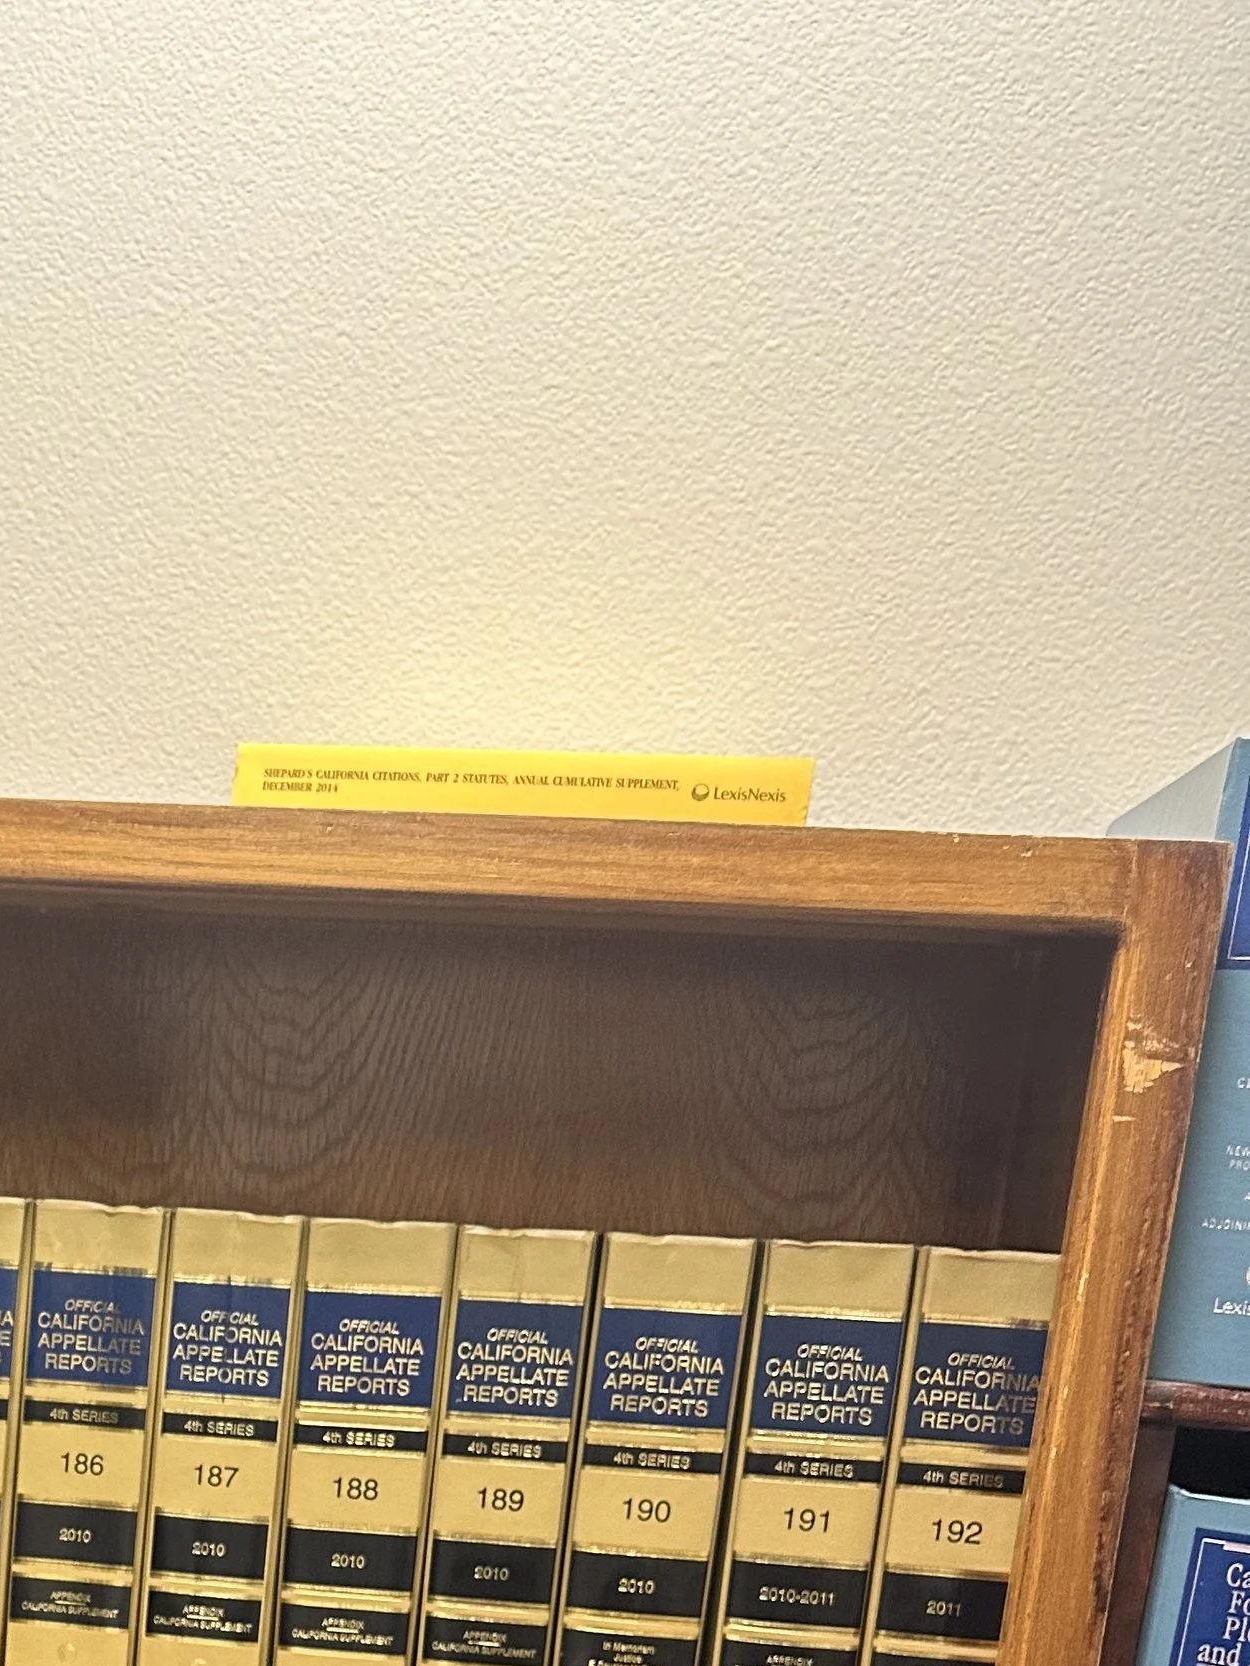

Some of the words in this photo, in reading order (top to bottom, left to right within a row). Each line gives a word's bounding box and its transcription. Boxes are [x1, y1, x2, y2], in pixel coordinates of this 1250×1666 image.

[262, 782, 312, 792] DECEMBER
[315, 783, 338, 793] 2014
[264, 769, 312, 779] SHEPARD'S
[316, 770, 369, 781] CALIFORNIA
[426, 773, 449, 783] PART
[453, 774, 459, 783] 2
[462, 774, 509, 785] STATUTES,
[513, 776, 549, 785] ANNUAL
[553, 776, 612, 788] CUMULATIVE
[616, 778, 679, 791] SUPPLEMENT,
[713, 786, 786, 803] LexisNexis
[38, 1312, 145, 1336] CALIFORNIA
[173, 1323, 282, 1347] CALIFORNIA
[339, 1318, 400, 1334] OFFICIAL
[38, 1333, 141, 1355] APPELLATE
[311, 1333, 424, 1355] CALIFORNIA
[487, 1328, 548, 1345] OFFICIAL
[636, 1336, 698, 1354] OFFICIAL
[172, 1345, 279, 1367] APPELLATE
[458, 1342, 574, 1365] CALIFORNIA
[604, 1351, 724, 1376] CALIFORNIA
[797, 1344, 863, 1362] OFFICIAL
[948, 1352, 1015, 1370] OFFICIAL
[45, 1354, 132, 1375] REPORTS
[311, 1354, 421, 1376] APPELLATE
[456, 1364, 570, 1387] APPELLATE
[765, 1358, 890, 1383] CALIFORNIA
[180, 1365, 269, 1387] REPORTS
[318, 1376, 410, 1396] REPORTS
[603, 1372, 720, 1396] APPELLATE
[915, 1366, 1041, 1393] CALIFORNIA
[464, 1385, 558, 1407] REPORTS
[764, 1380, 884, 1404] APPELLATE
[913, 1389, 1036, 1414] APPELLATE
[610, 1394, 708, 1418] REPORTS
[771, 1402, 872, 1426] REPORTS
[184, 1422, 203, 1433] 4th
[207, 1423, 254, 1437] SERIES
[920, 1411, 1024, 1436] REPORTS
[322, 1433, 342, 1444] 4th
[346, 1432, 395, 1447] SERIES
[467, 1442, 487, 1454] 4th
[491, 1442, 542, 1458] SERIES
[61, 1452, 104, 1476] 186
[613, 1454, 632, 1464] 4th
[638, 1454, 690, 1470] SERIES
[774, 1462, 794, 1474] 4th
[800, 1462, 854, 1478] SERIES
[194, 1465, 239, 1487] 187
[923, 1470, 944, 1484] 4th
[950, 1471, 1003, 1488] SERIES
[333, 1477, 378, 1501] 188
[478, 1487, 524, 1511] 189
[622, 1497, 670, 1524] 190
[784, 1508, 830, 1533] 191
[59, 1528, 92, 1543] 2010
[932, 1518, 983, 1546] 192
[192, 1542, 225, 1556] 2010
[331, 1554, 365, 1569] 2010
[474, 1566, 509, 1581] 2010
[618, 1577, 655, 1594] 2010
[759, 1585, 834, 1606] 2010-2011
[926, 1600, 962, 1616] 2011
